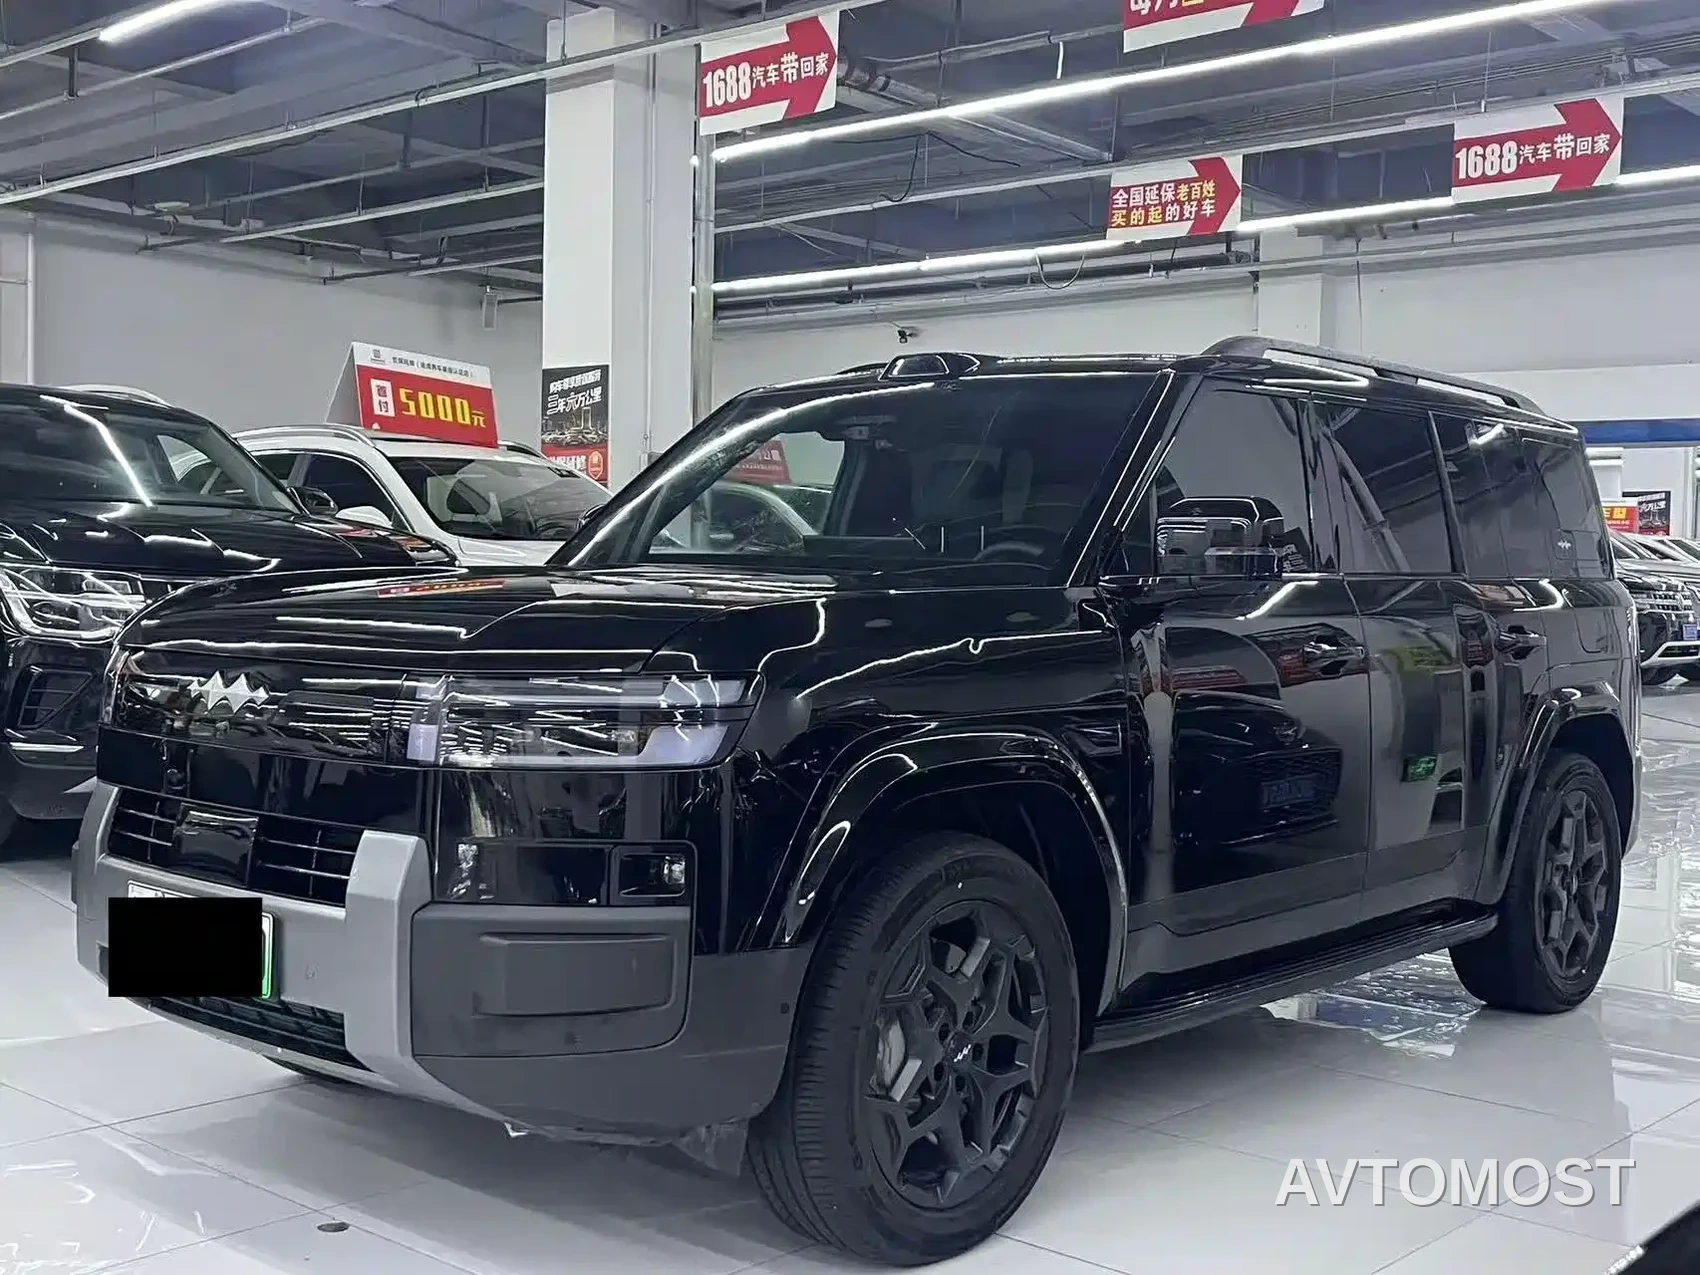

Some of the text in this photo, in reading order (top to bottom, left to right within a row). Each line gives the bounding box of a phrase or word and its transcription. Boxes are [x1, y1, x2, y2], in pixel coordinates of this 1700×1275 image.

[703, 52, 829, 108] 1688汽车带回家
[1455, 133, 1611, 179] 1688汽车带回家
[1111, 198, 1216, 227] 买的起的好车
[1112, 179, 1216, 208] 全国延保老百姓
[399, 387, 487, 428] 5000元
